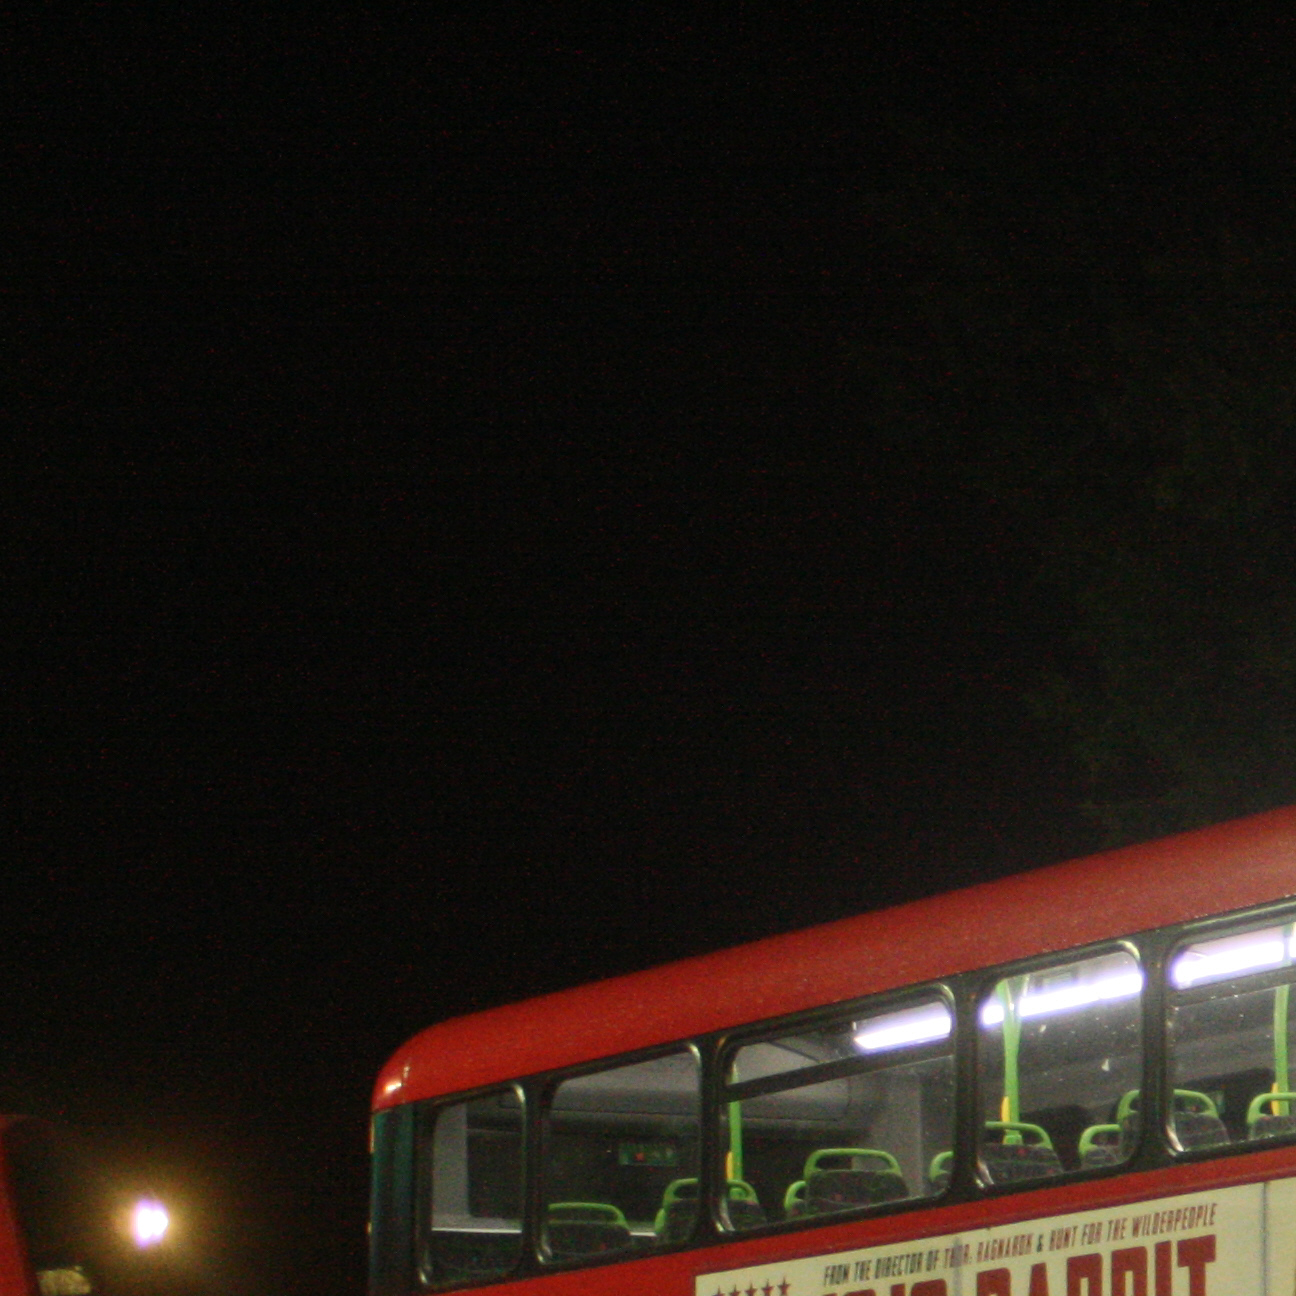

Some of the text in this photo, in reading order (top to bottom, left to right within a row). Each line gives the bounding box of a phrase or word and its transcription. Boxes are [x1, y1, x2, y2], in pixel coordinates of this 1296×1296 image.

[823, 1263, 849, 1286] FROM
[854, 1259, 872, 1282] THE
[875, 1251, 924, 1280] DIRECTOR
[926, 1249, 939, 1273] OF
[976, 1232, 1033, 1263] RAGNAROK
[1036, 1234, 1043, 1254] &
[1049, 1225, 1078, 1252] HUNT
[1081, 1221, 1103, 1246] FOR
[1107, 1217, 1128, 1242] THE
[1132, 1203, 1218, 1238] WILDERPEOPLE
